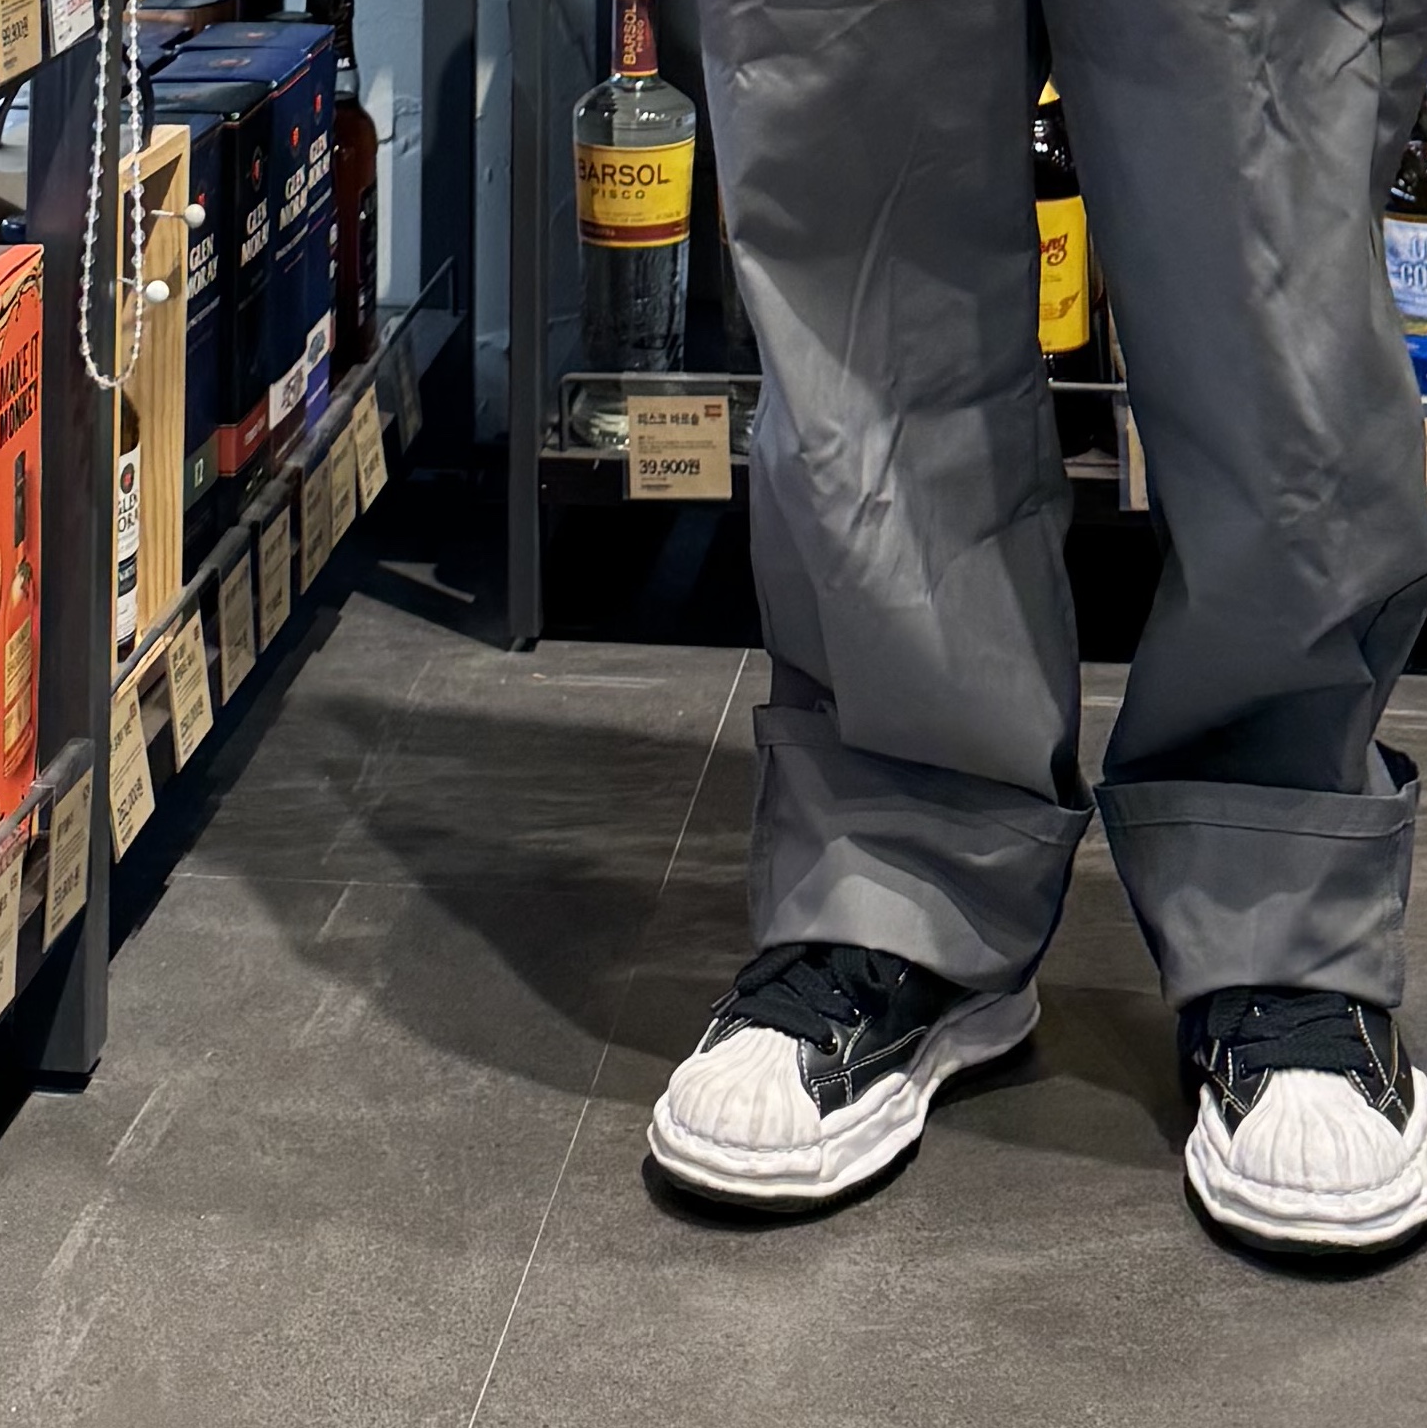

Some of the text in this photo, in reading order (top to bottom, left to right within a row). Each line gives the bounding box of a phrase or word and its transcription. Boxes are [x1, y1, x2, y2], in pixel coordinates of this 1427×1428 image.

[622, 2, 638, 65] BARSOL
[577, 158, 672, 187] BARSOL
[590, 187, 646, 200] PISCO
